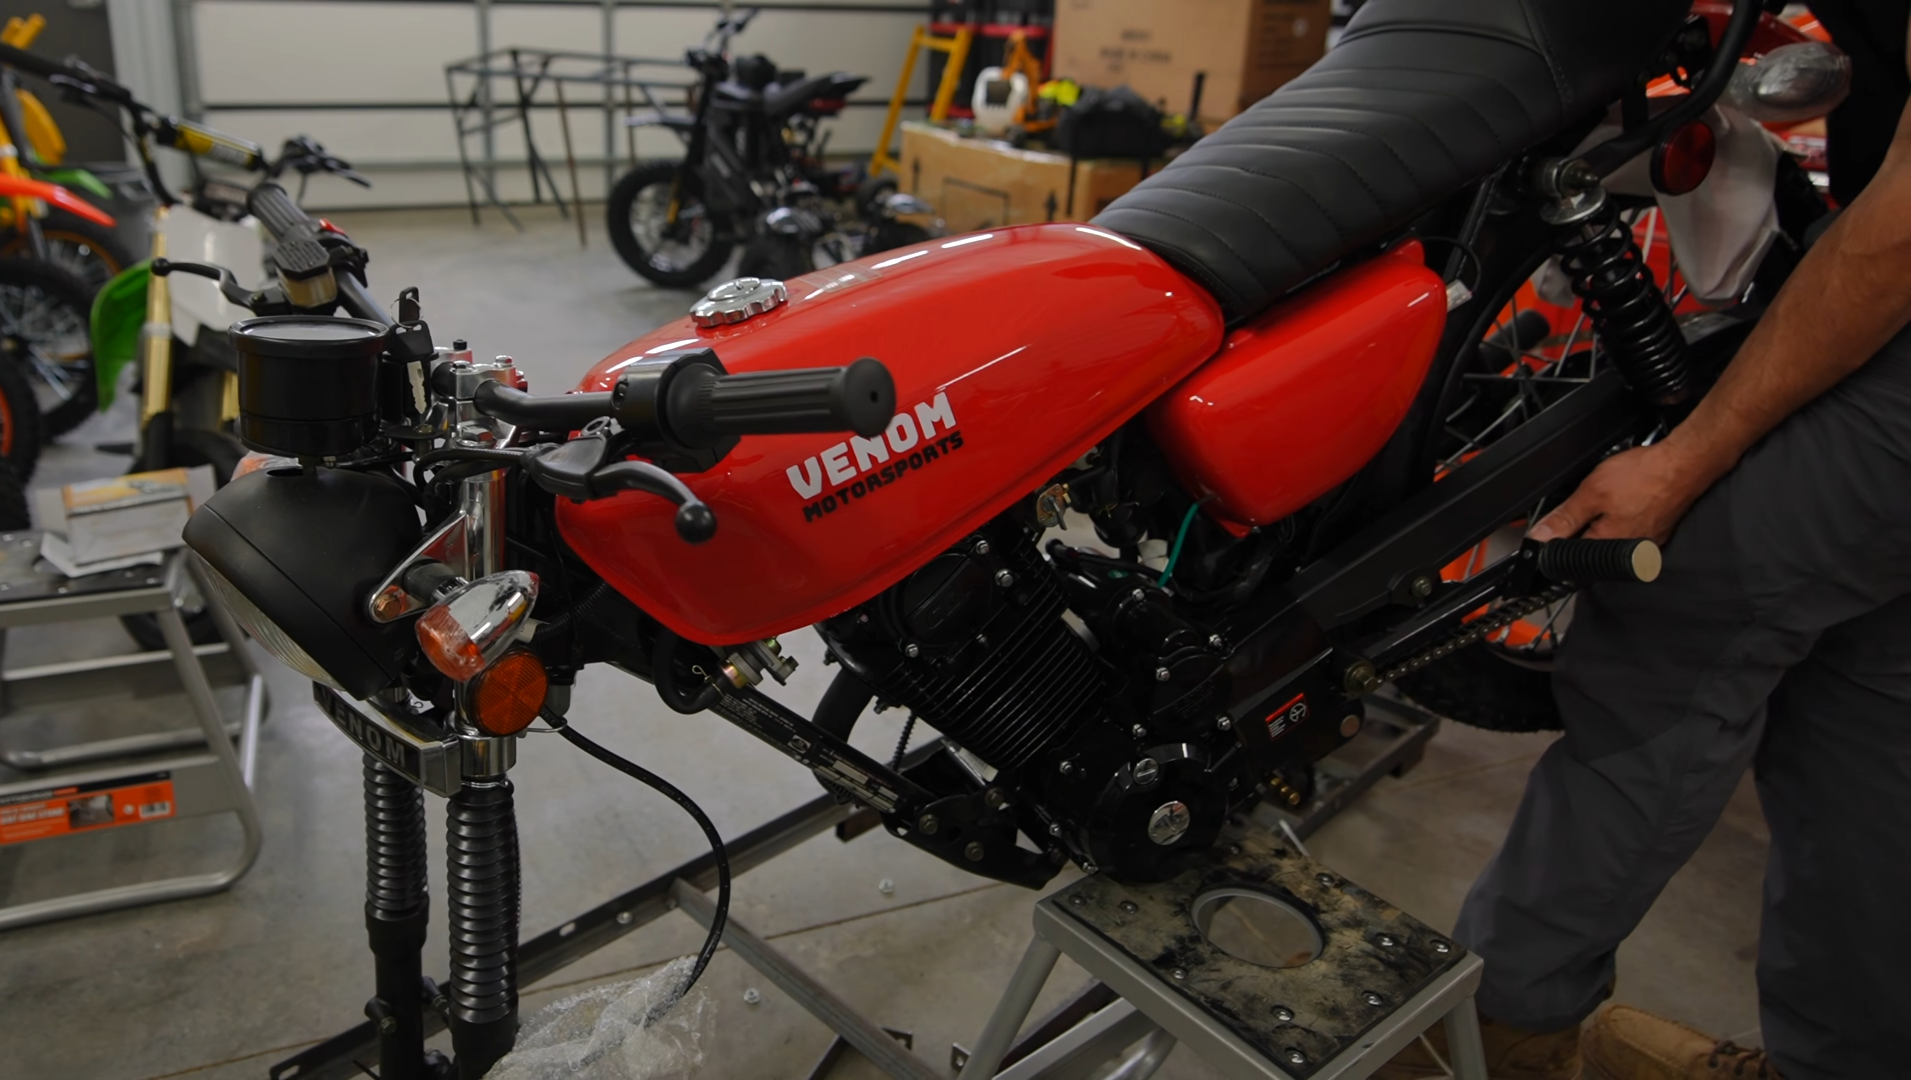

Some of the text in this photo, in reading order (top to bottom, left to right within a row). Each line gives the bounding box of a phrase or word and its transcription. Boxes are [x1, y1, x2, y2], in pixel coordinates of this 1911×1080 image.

[785, 391, 957, 500] VENOM
[802, 430, 964, 523] MOTORSPORTS
[320, 685, 406, 768] VENOM
